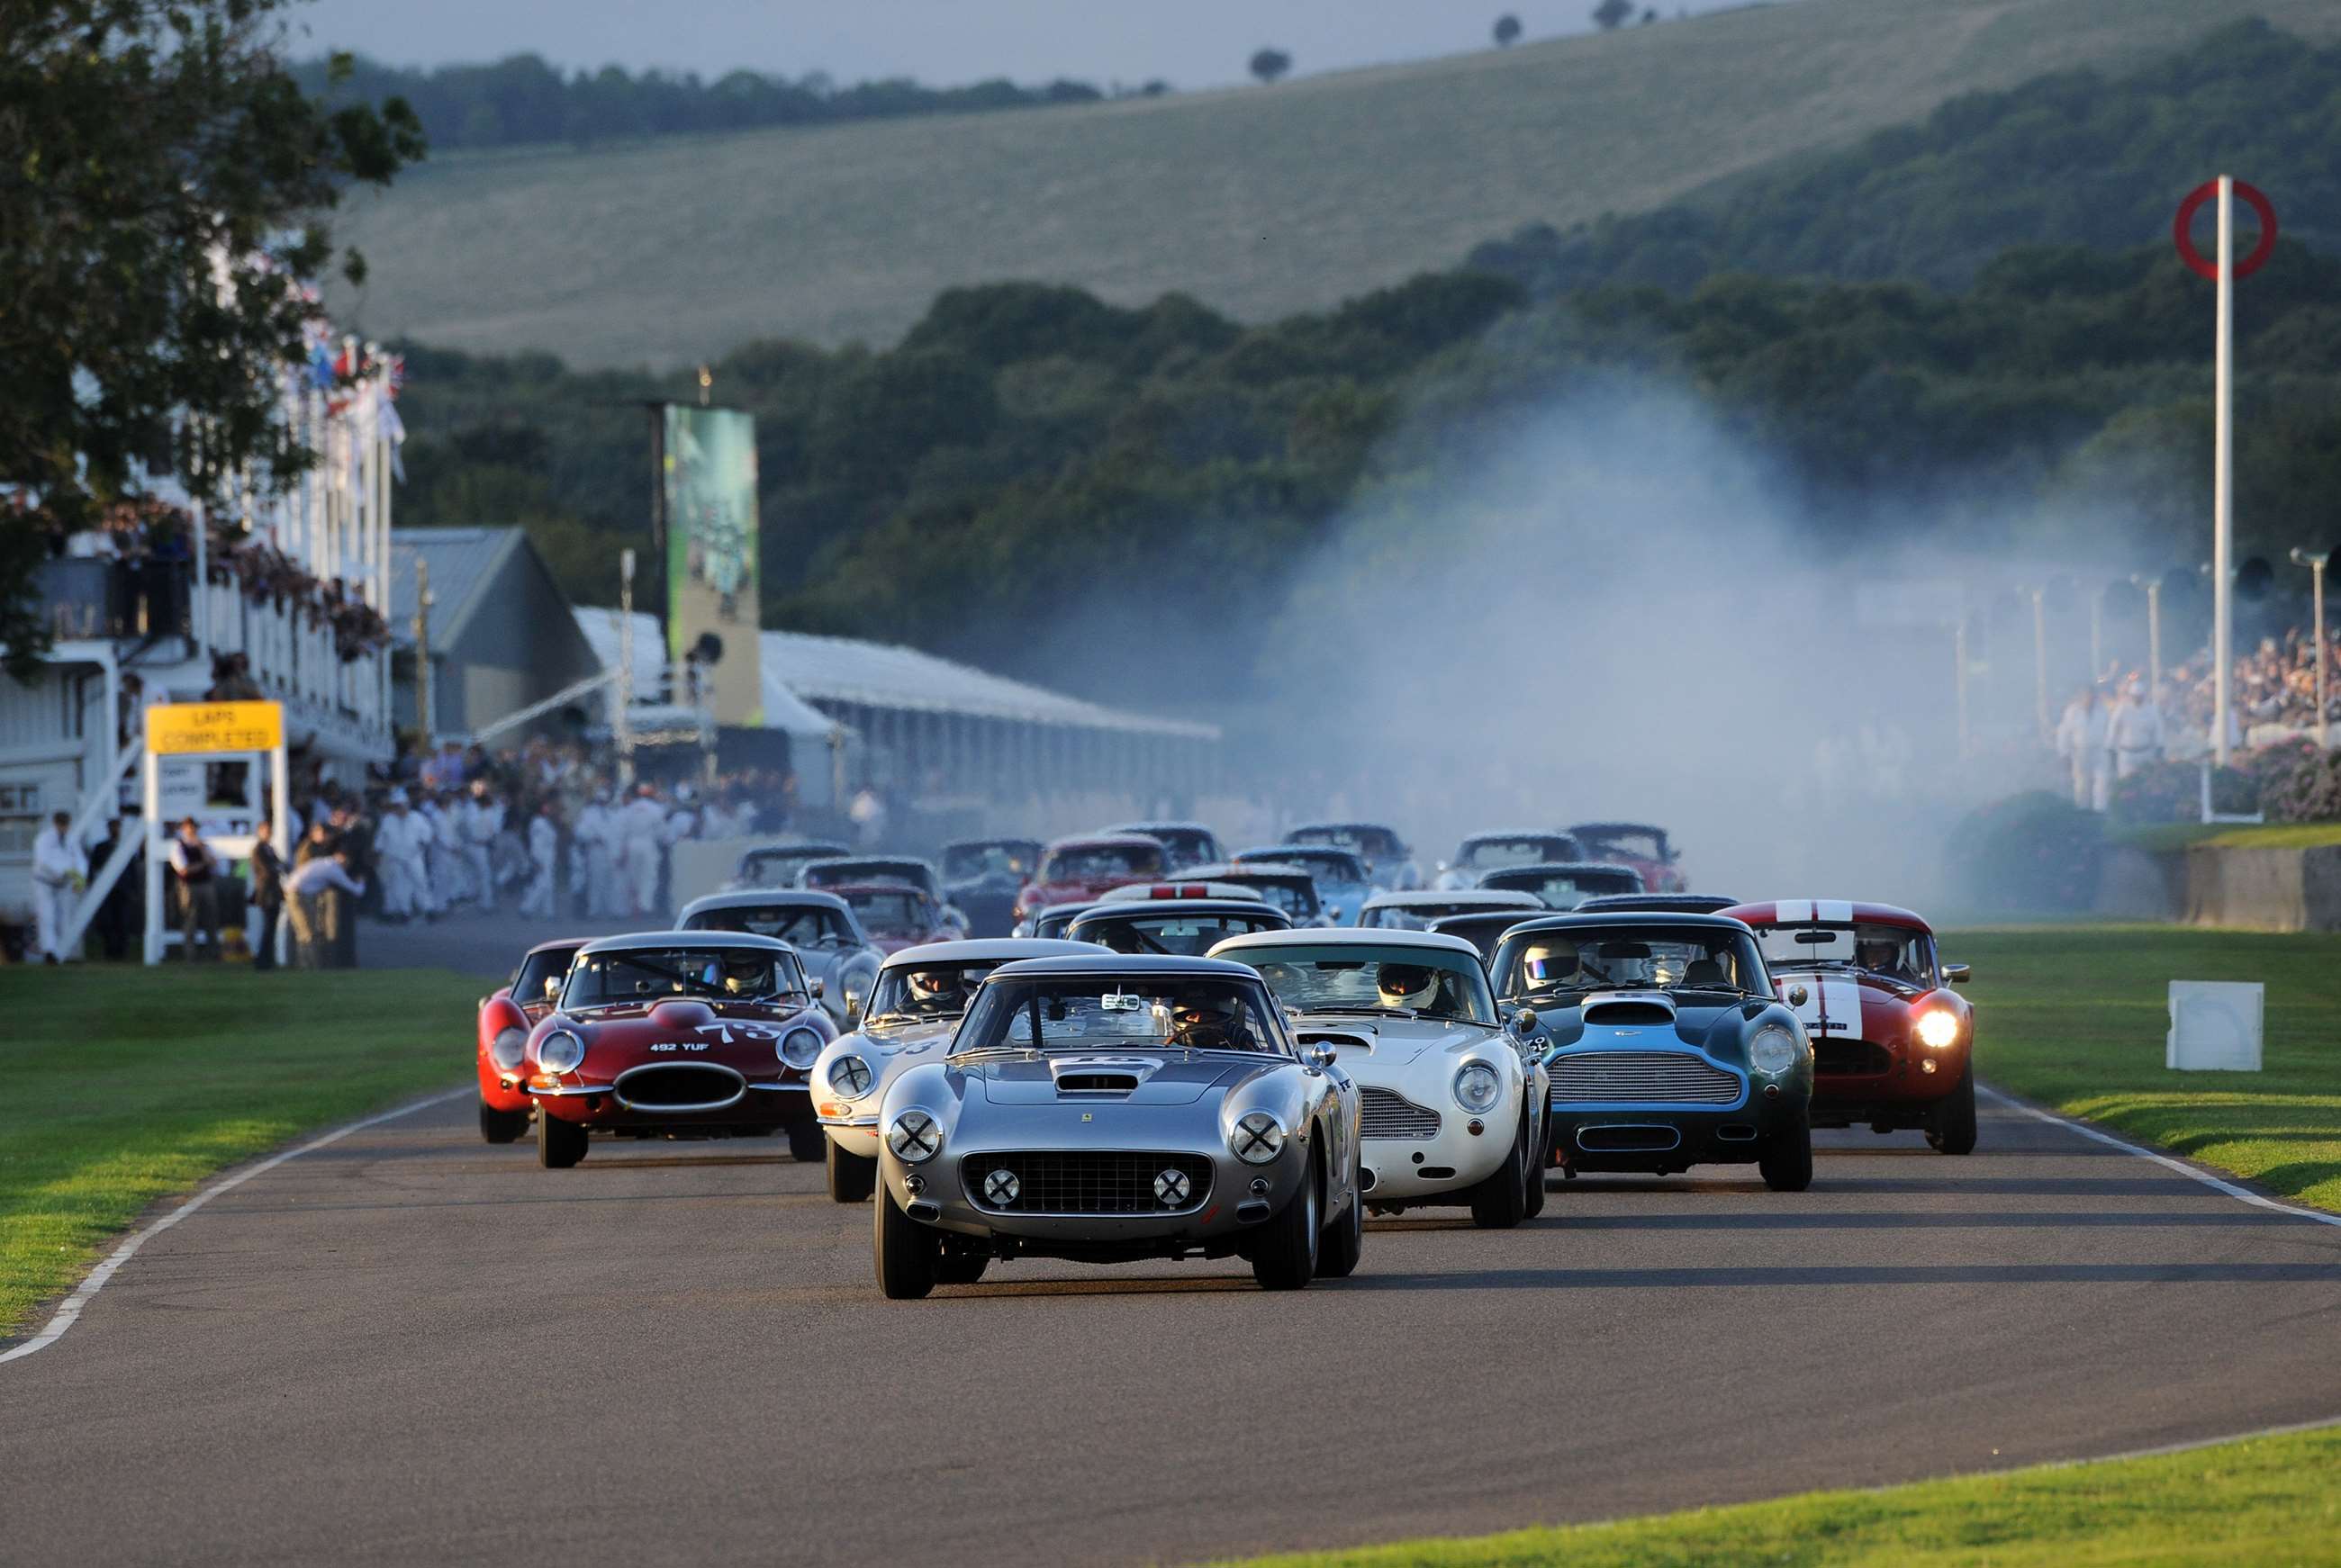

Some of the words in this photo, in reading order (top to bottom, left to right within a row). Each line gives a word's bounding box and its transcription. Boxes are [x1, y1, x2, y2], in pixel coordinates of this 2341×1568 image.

[194, 710, 236, 725] LAPS
[161, 730, 269, 750] COMPLETED
[694, 1023, 782, 1044] 73
[650, 1043, 676, 1052] 492
[682, 1043, 710, 1051] YUF
